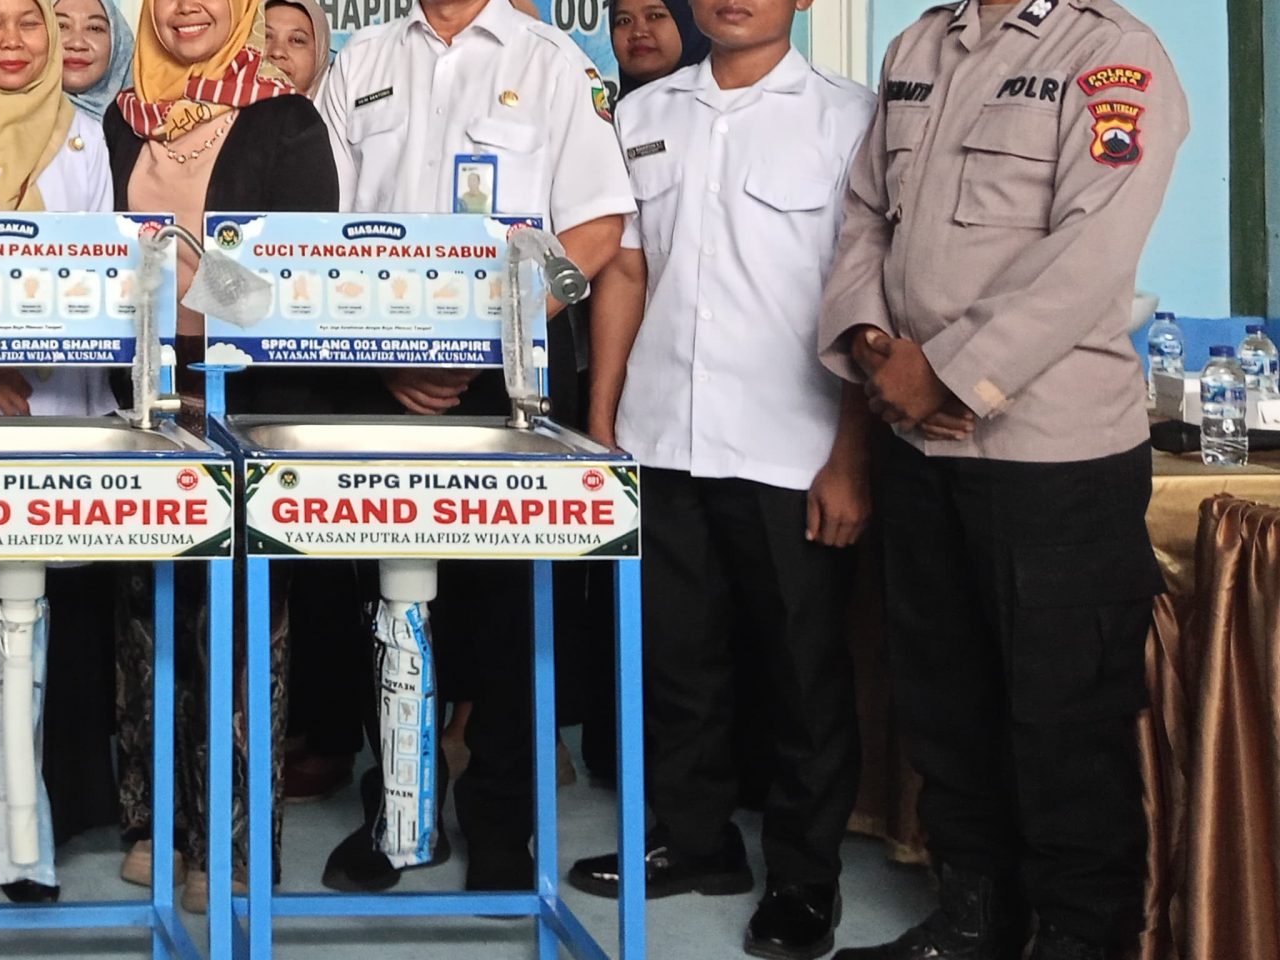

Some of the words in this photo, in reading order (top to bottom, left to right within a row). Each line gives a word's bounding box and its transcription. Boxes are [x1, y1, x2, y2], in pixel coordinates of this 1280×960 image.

[1088, 68, 1142, 86] POLRES
[347, 224, 401, 237] BIASAKAN
[9, 244, 63, 256] PAKAI
[67, 244, 128, 257] SABUN
[253, 244, 293, 257] CUCI
[298, 244, 370, 257] TANGAN
[376, 245, 431, 258] PAKAI
[436, 246, 497, 258] SABUN
[11, 340, 58, 350] GRAND
[62, 340, 121, 350] SHAPIRE
[261, 340, 296, 350] SPPG
[301, 340, 350, 350] PILANG
[354, 340, 376, 350] 001
[381, 340, 427, 350] GRAND
[432, 341, 490, 351] SHAPIRE
[68, 351, 114, 360] KUSUMA
[268, 351, 317, 361] YAYASAN
[357, 351, 395, 360] HAFIDZ
[438, 352, 484, 362] KUSUMA
[3, 474, 93, 490] PILANG
[100, 474, 142, 490] 001
[337, 474, 401, 489] SPPG
[409, 474, 498, 490] PILANG
[506, 475, 548, 490] 001
[27, 499, 208, 526] SHAPIRE
[272, 498, 418, 524] GRAND
[433, 499, 615, 525] SHAPIRE
[7, 534, 64, 546] HAFIDZ
[67, 534, 124, 546] WIJAYA
[128, 533, 195, 545] KUSUMA
[285, 531, 356, 543] YAYASAN
[360, 531, 412, 543] PUTRA
[415, 532, 470, 544] HAFIDZ
[474, 532, 531, 545] WIJAYA
[535, 533, 602, 544] KUSUMA
